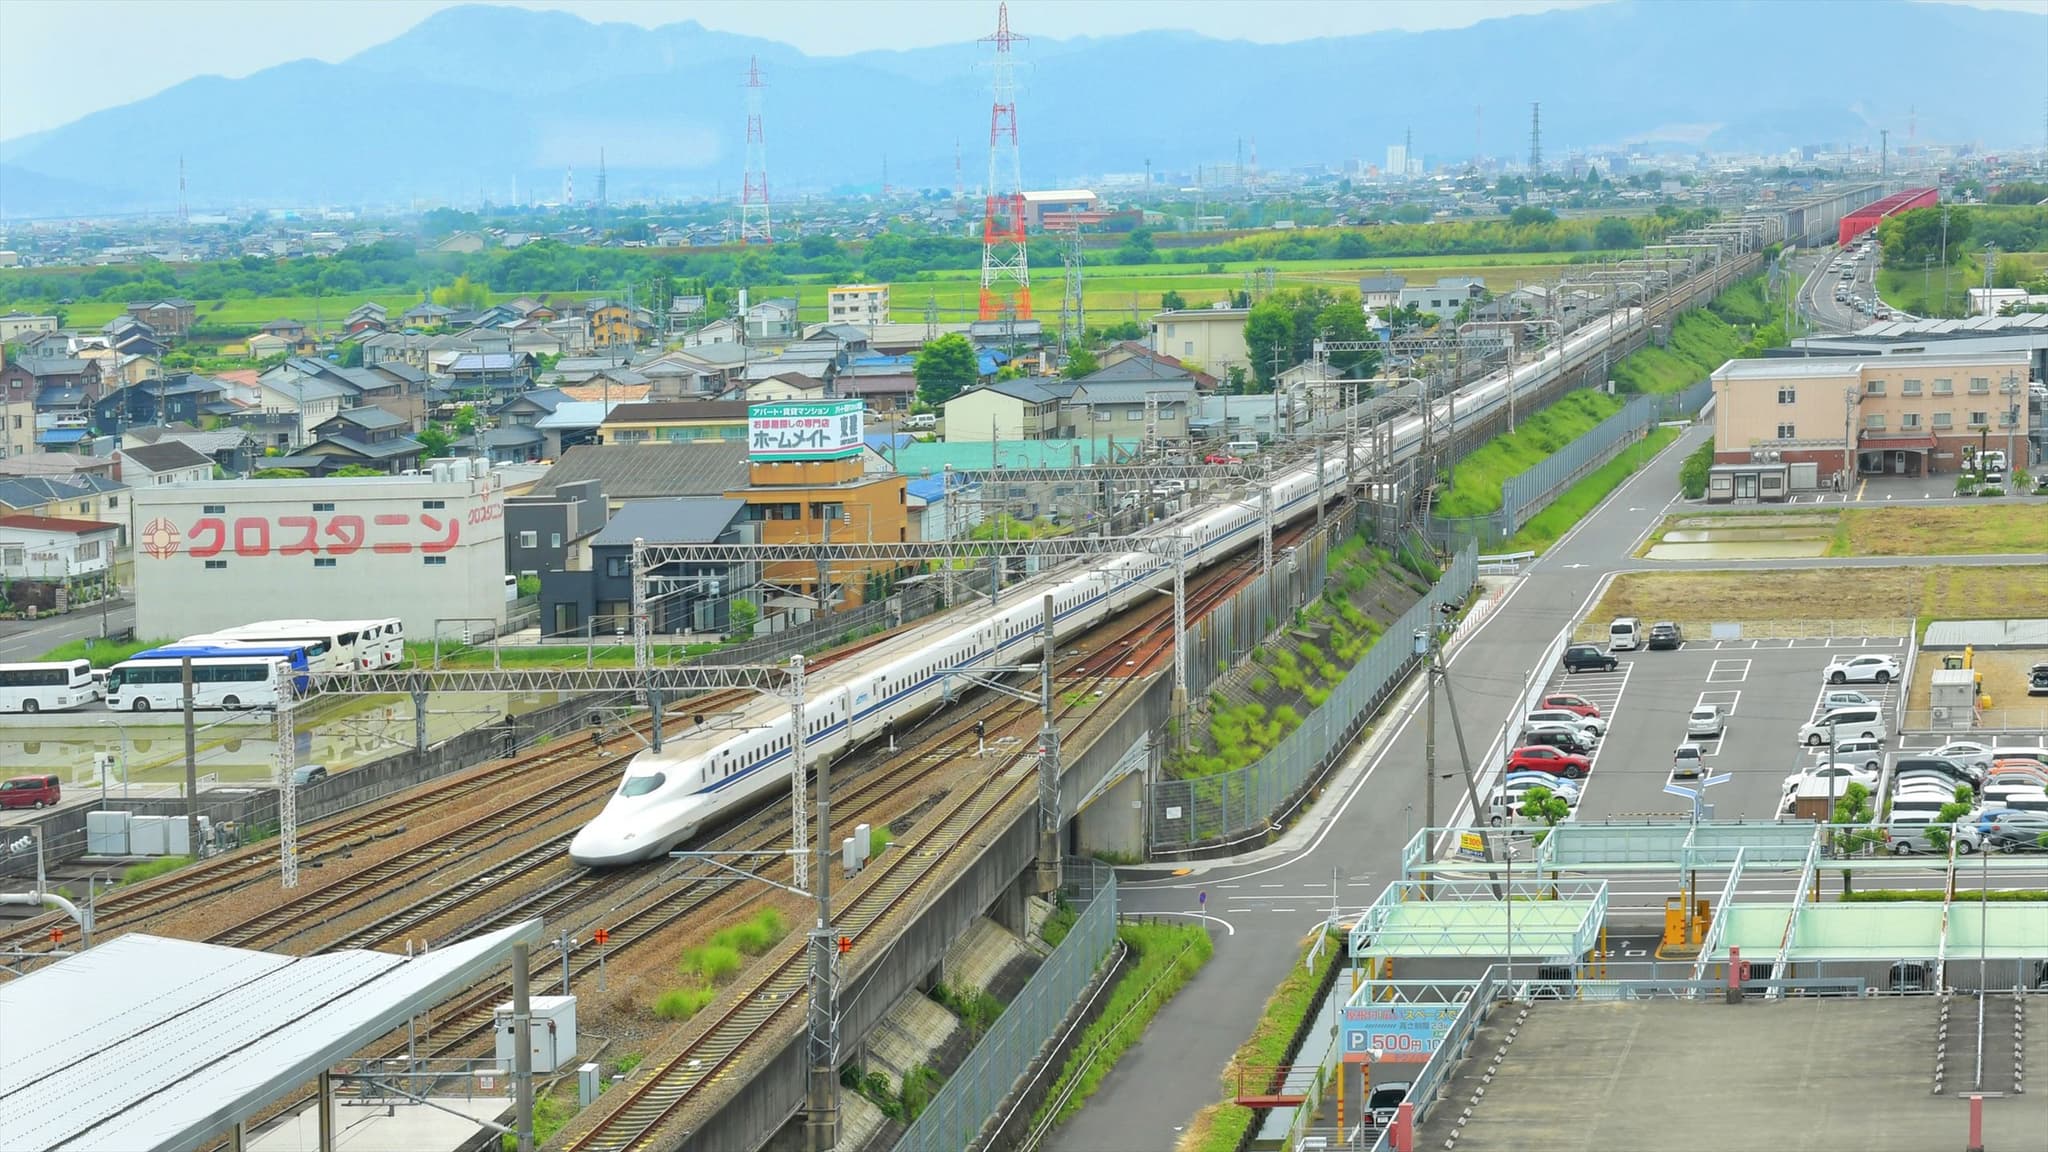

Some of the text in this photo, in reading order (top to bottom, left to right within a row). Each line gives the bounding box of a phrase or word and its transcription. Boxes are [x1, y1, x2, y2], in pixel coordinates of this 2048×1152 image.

[753, 429, 831, 449] ホームメイト
[468, 503, 503, 526] クロスタニン
[188, 514, 460, 558] クロスタニン
